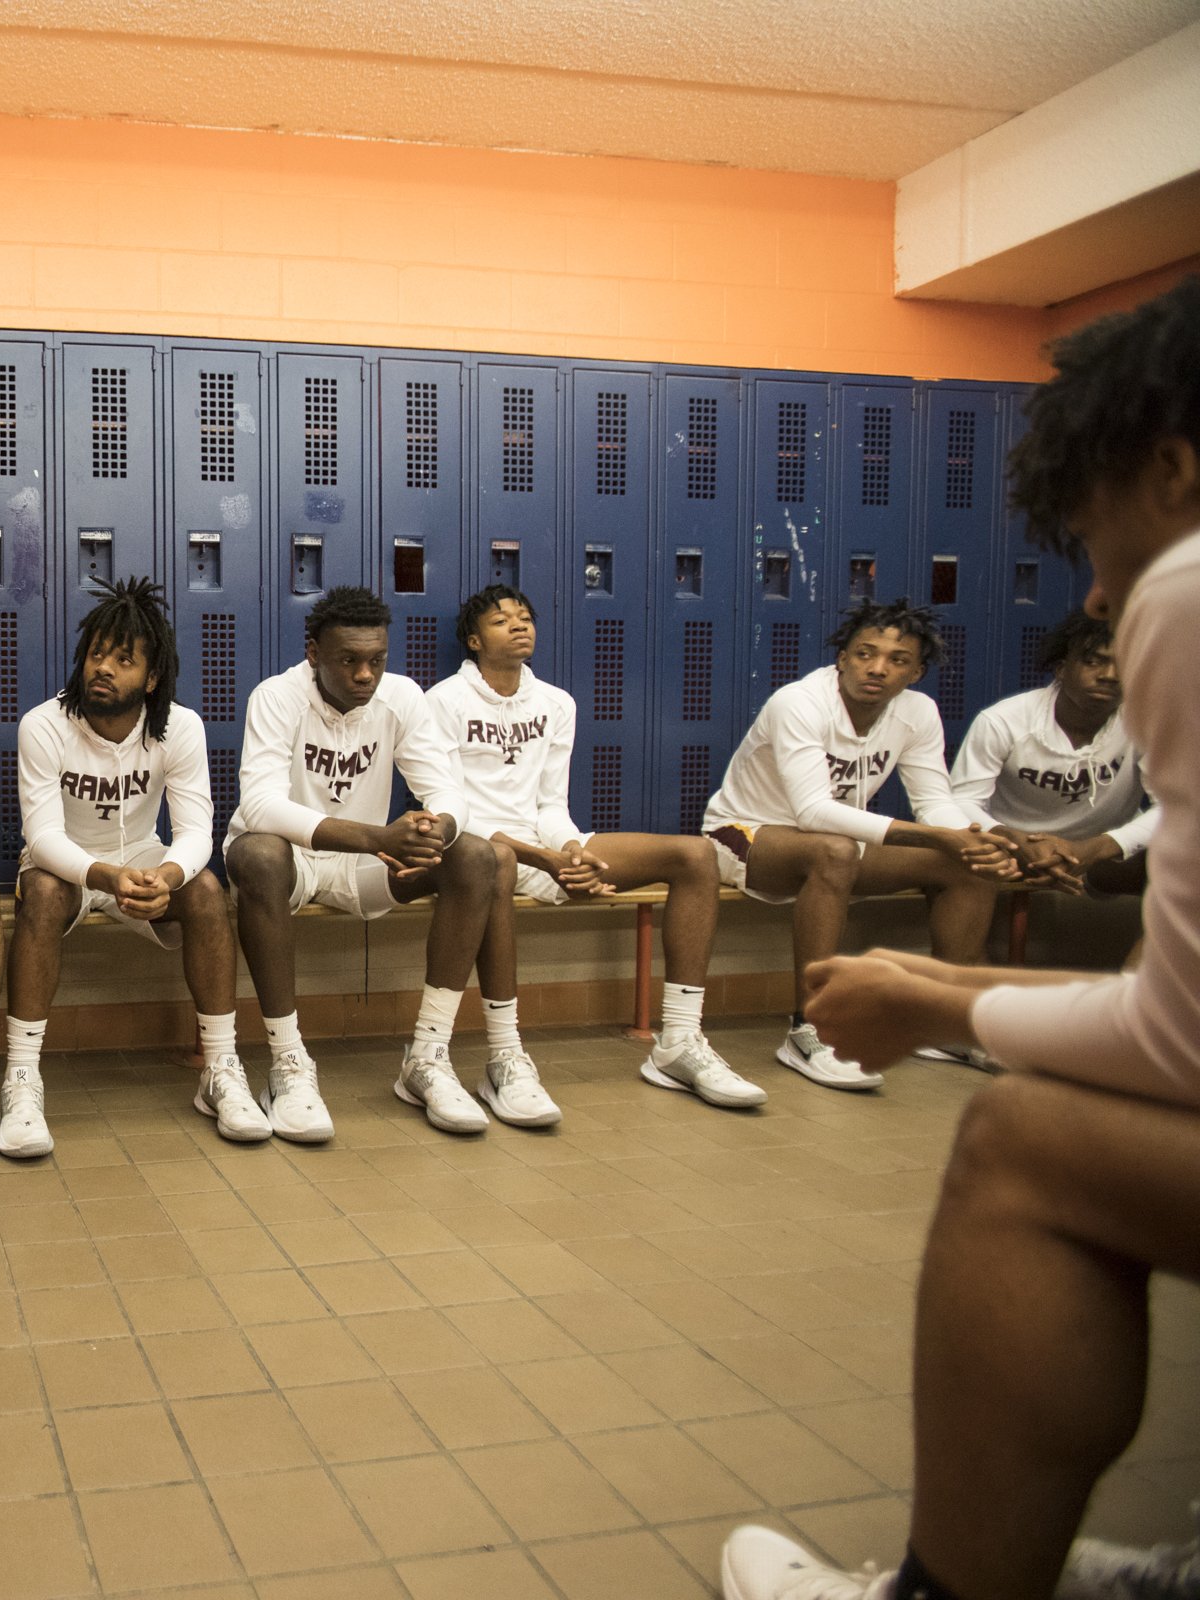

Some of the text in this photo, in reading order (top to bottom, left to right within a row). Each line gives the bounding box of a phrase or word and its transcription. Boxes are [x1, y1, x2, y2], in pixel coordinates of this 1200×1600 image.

[467, 714, 547, 745] RAMILY
[305, 741, 377, 778] RAMLY
[502, 747, 522, 765] T
[1018, 756, 1124, 792] RAML
[329, 781, 352, 803] T
[95, 804, 120, 820] T
